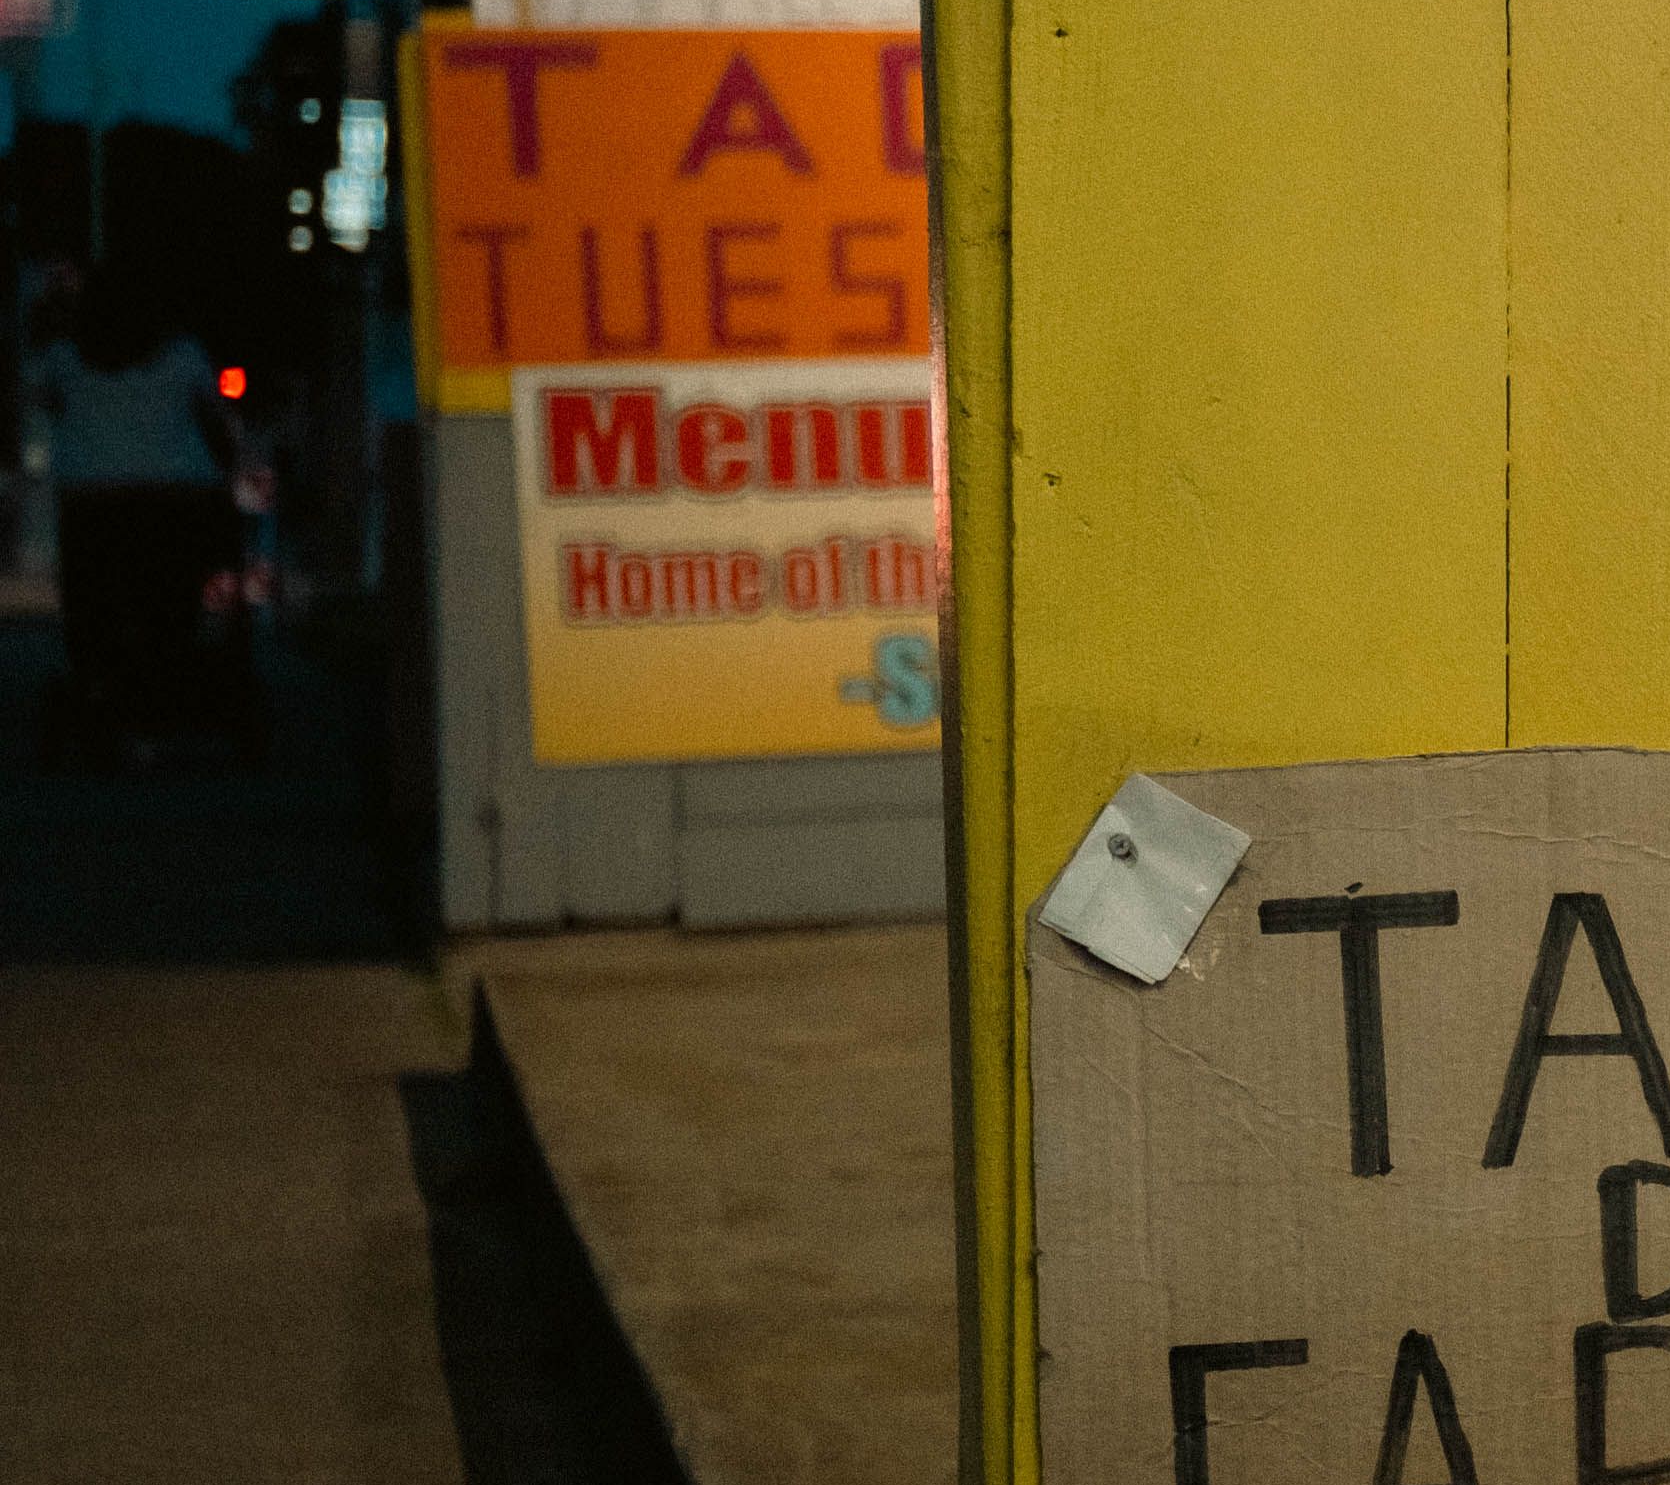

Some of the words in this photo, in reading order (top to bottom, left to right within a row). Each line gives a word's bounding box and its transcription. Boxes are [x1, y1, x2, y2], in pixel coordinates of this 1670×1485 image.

[453, 220, 909, 358] TUES
[543, 385, 932, 495] Menu
[562, 540, 766, 625] Home
[783, 533, 847, 615] of
